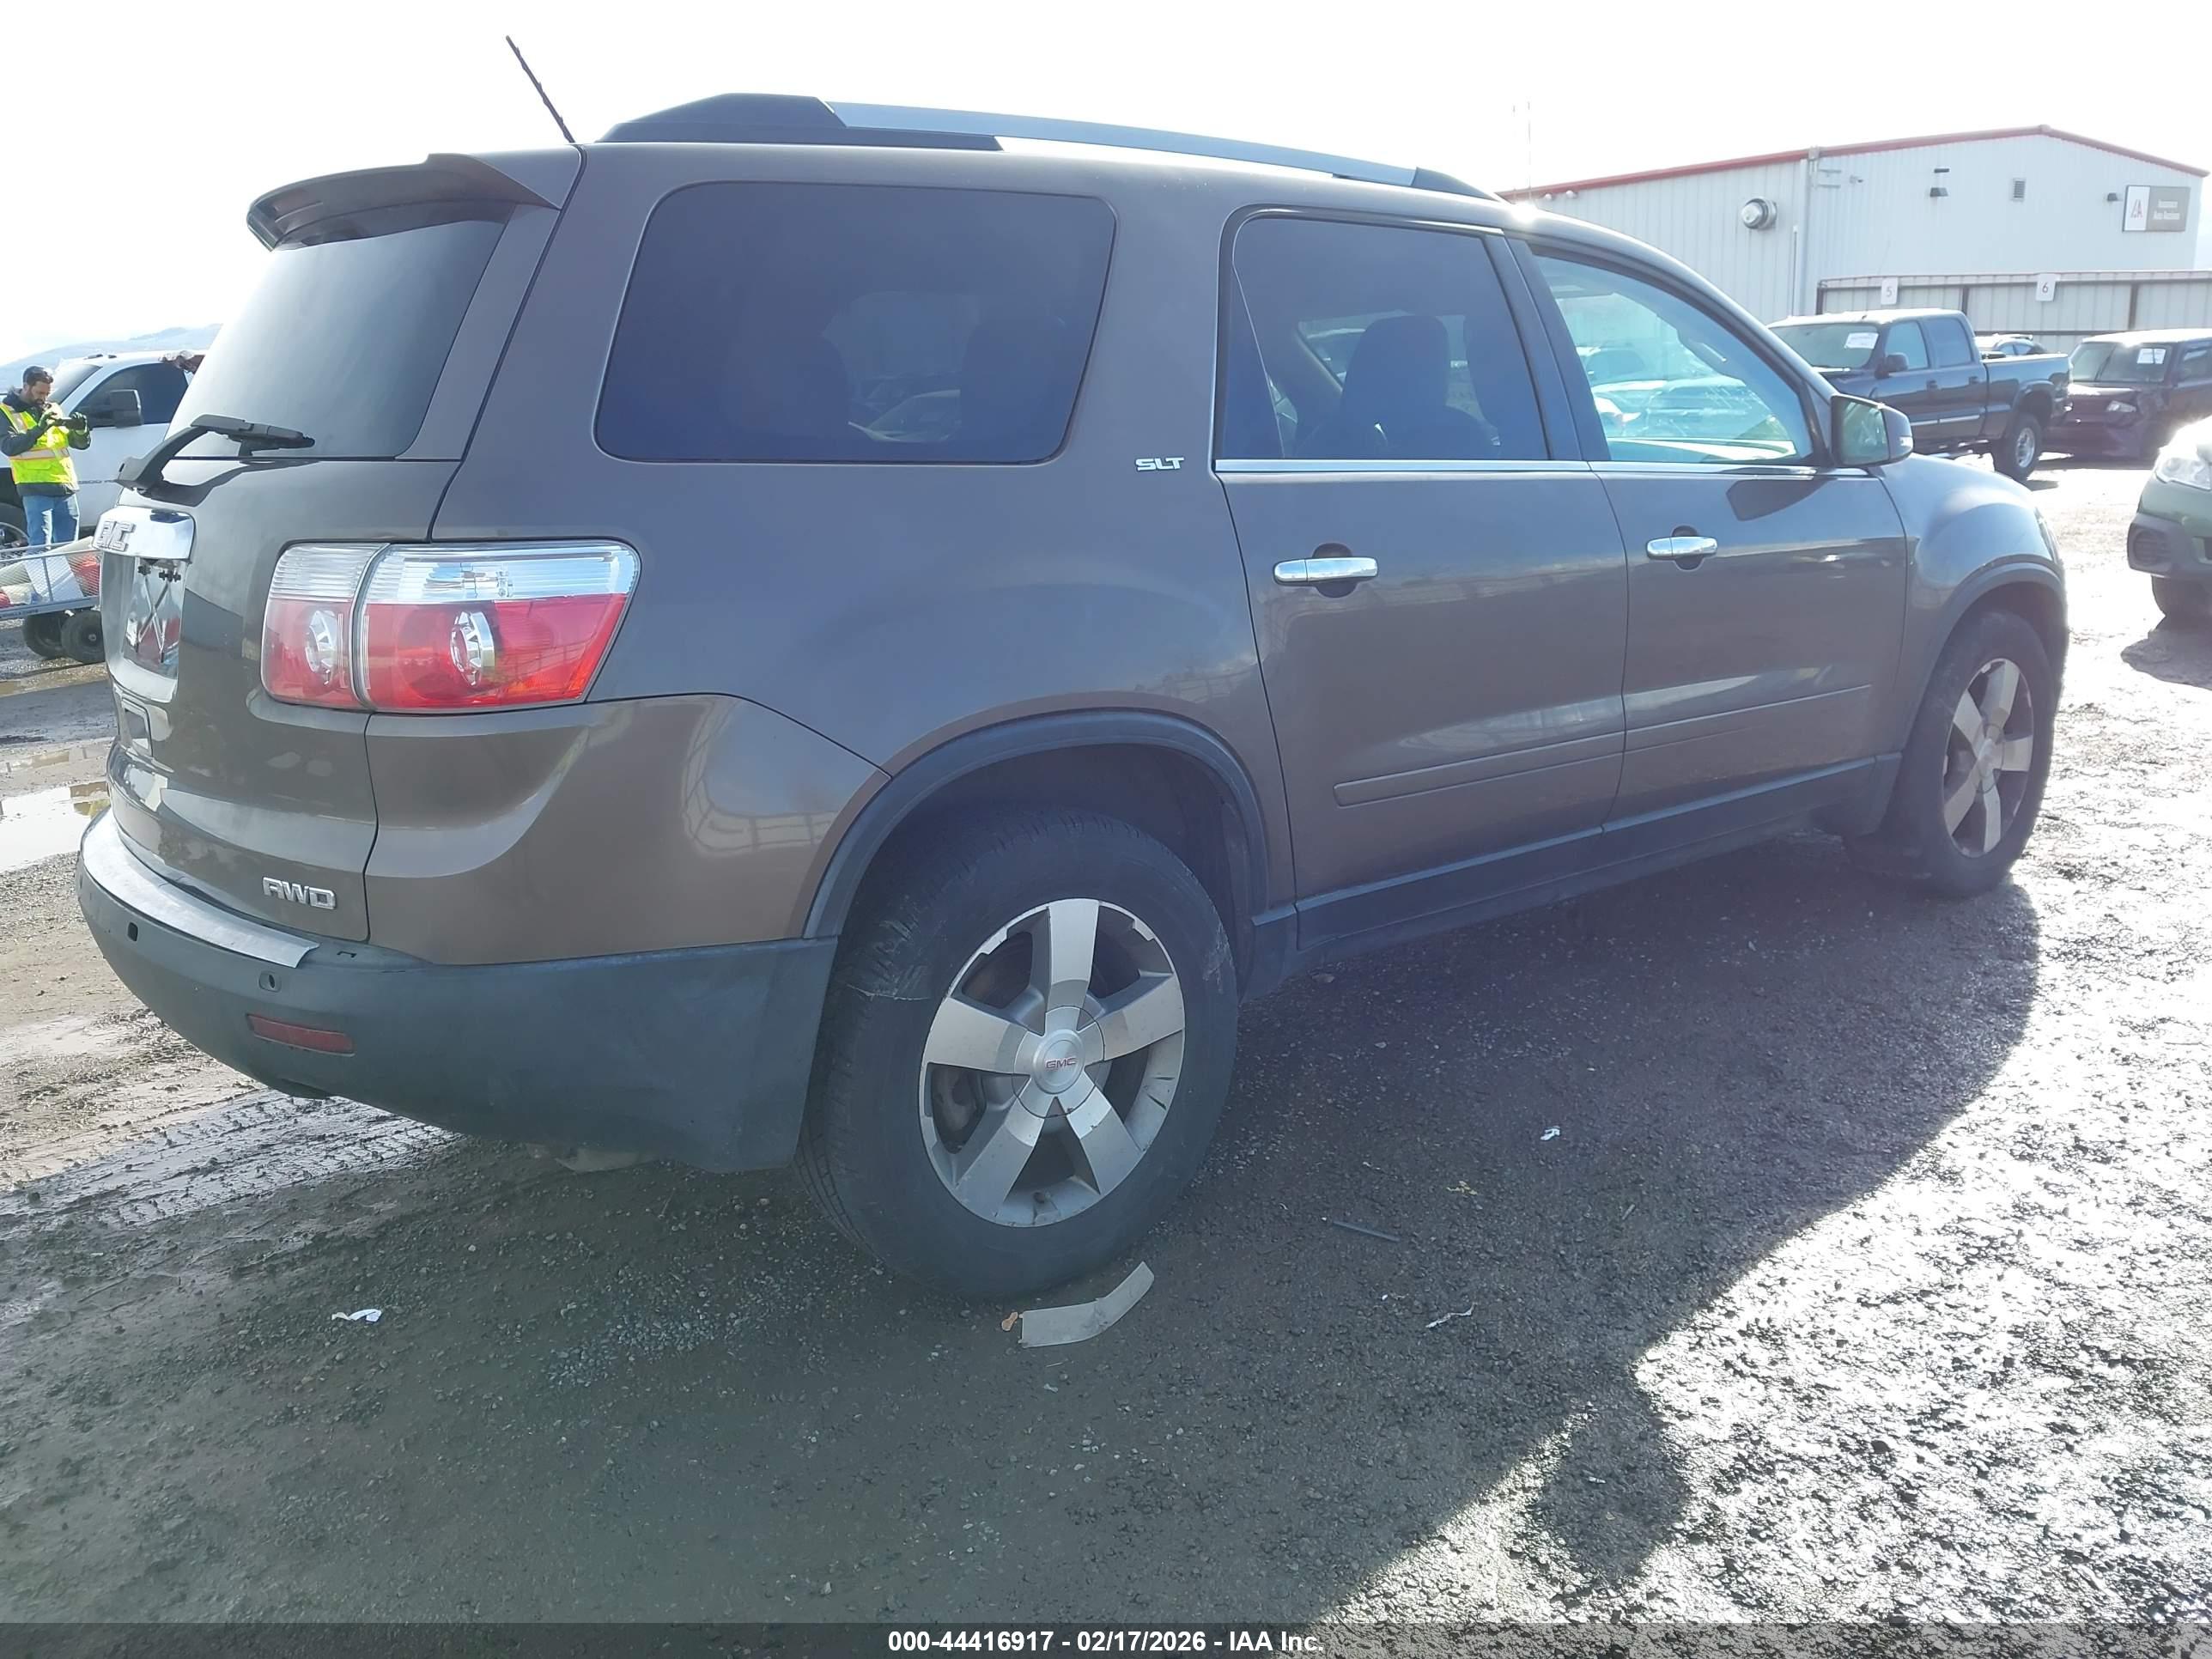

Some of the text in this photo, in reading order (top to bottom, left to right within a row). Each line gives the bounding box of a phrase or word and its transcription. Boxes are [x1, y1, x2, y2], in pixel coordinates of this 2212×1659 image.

[1886, 286, 1893, 298] 5
[2042, 282, 2049, 294] 6
[1135, 457, 1184, 471] SLT
[263, 877, 336, 910] AWD
[1045, 1056, 1078, 1069] GMC
